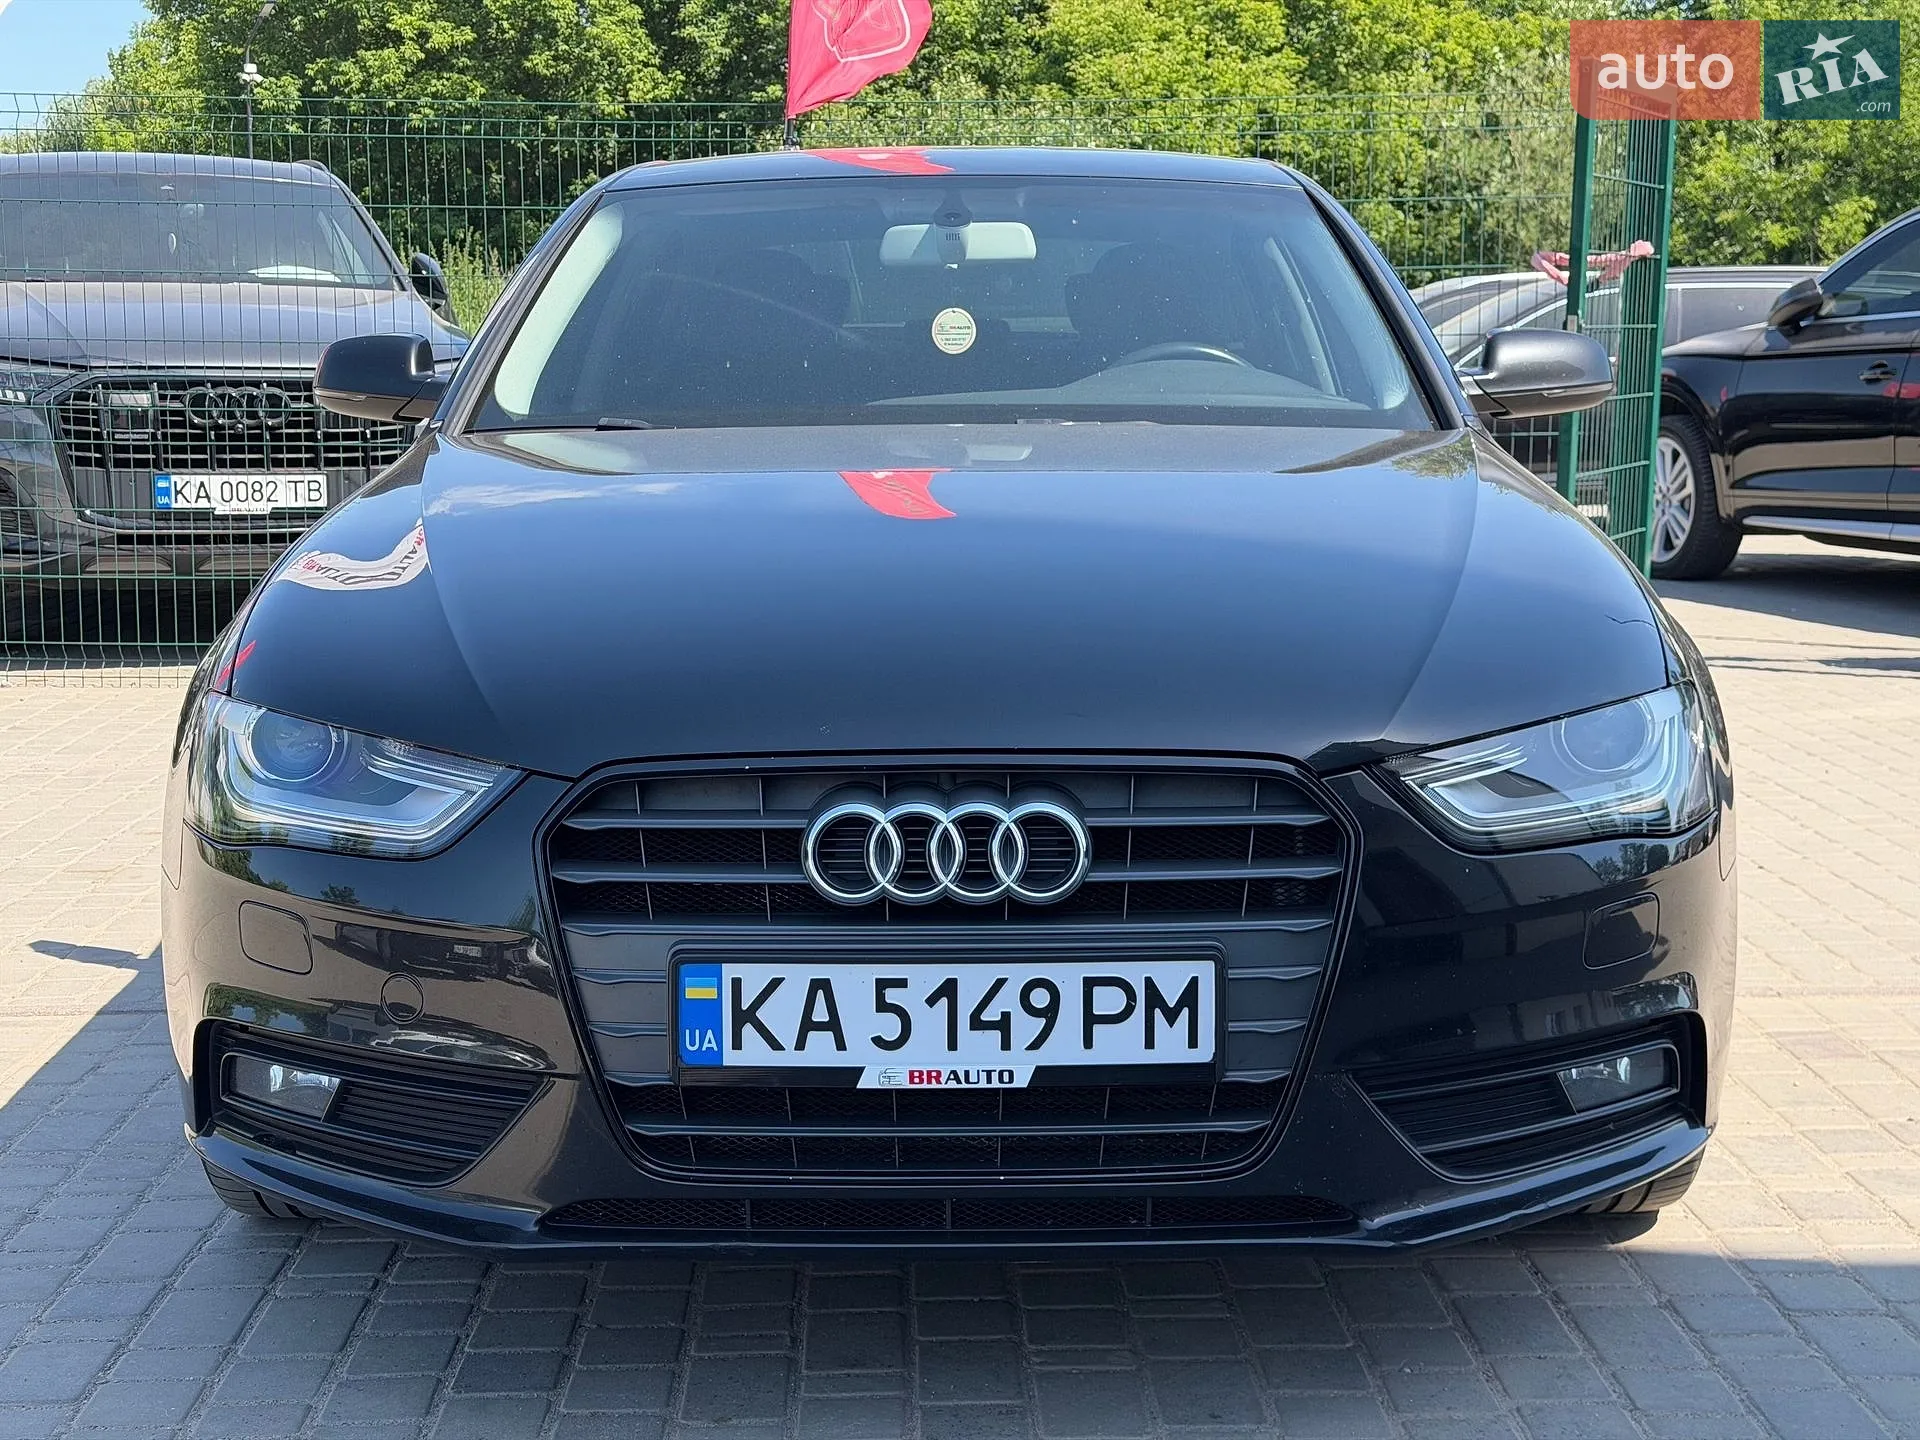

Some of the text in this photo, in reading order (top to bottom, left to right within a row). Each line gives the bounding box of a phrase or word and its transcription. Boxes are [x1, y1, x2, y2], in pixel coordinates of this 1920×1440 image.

[157, 495, 171, 504] UA
[173, 480, 211, 503] KA
[220, 480, 279, 503] 0082
[731, 975, 1200, 1052] KA 5149 PM
[684, 1029, 719, 1052] UA
[908, 1069, 1015, 1085] BRAUTO
